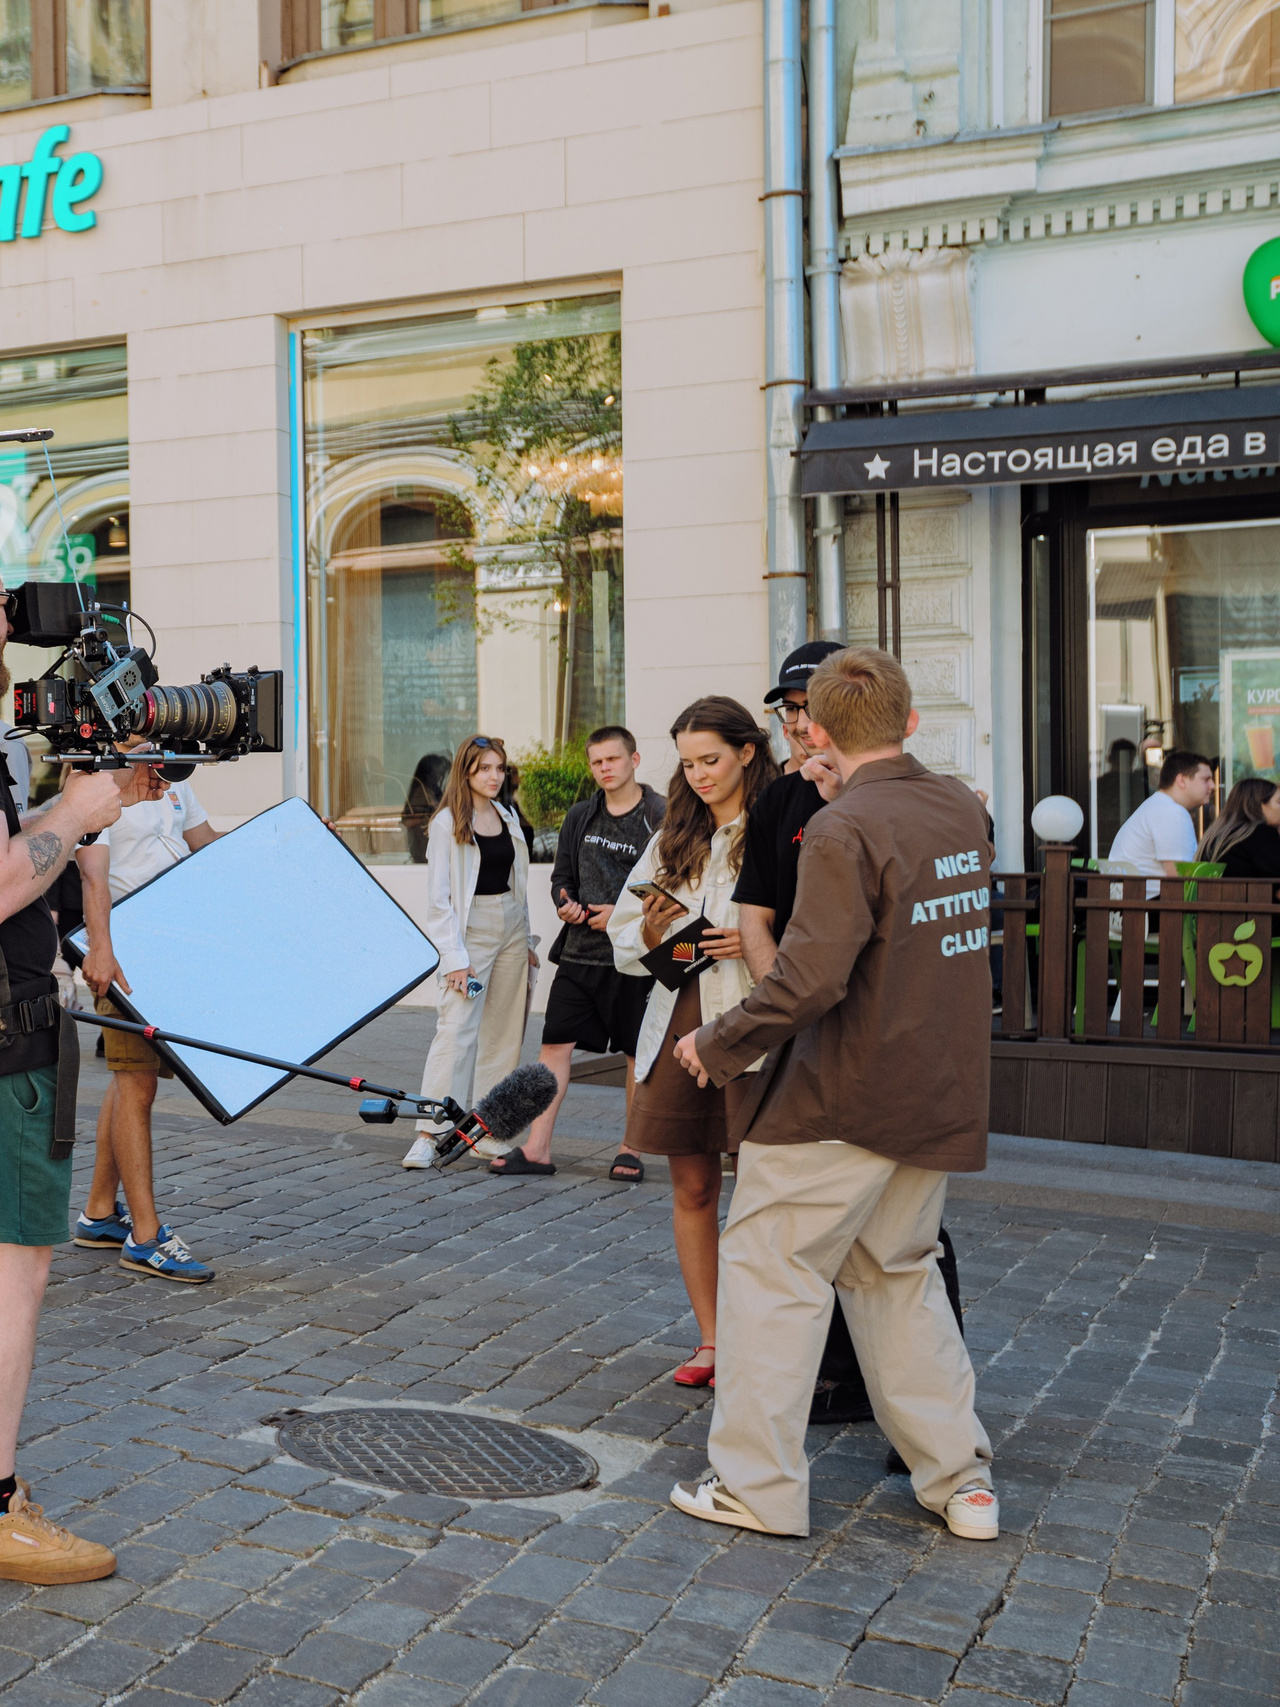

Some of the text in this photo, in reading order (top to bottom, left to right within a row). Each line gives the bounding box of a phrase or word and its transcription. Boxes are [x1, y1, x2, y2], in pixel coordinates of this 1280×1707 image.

[913, 440, 1138, 479] Настоящая
[1150, 433, 1229, 466] еда
[1243, 431, 1267, 456] в
[934, 850, 982, 880] NICE
